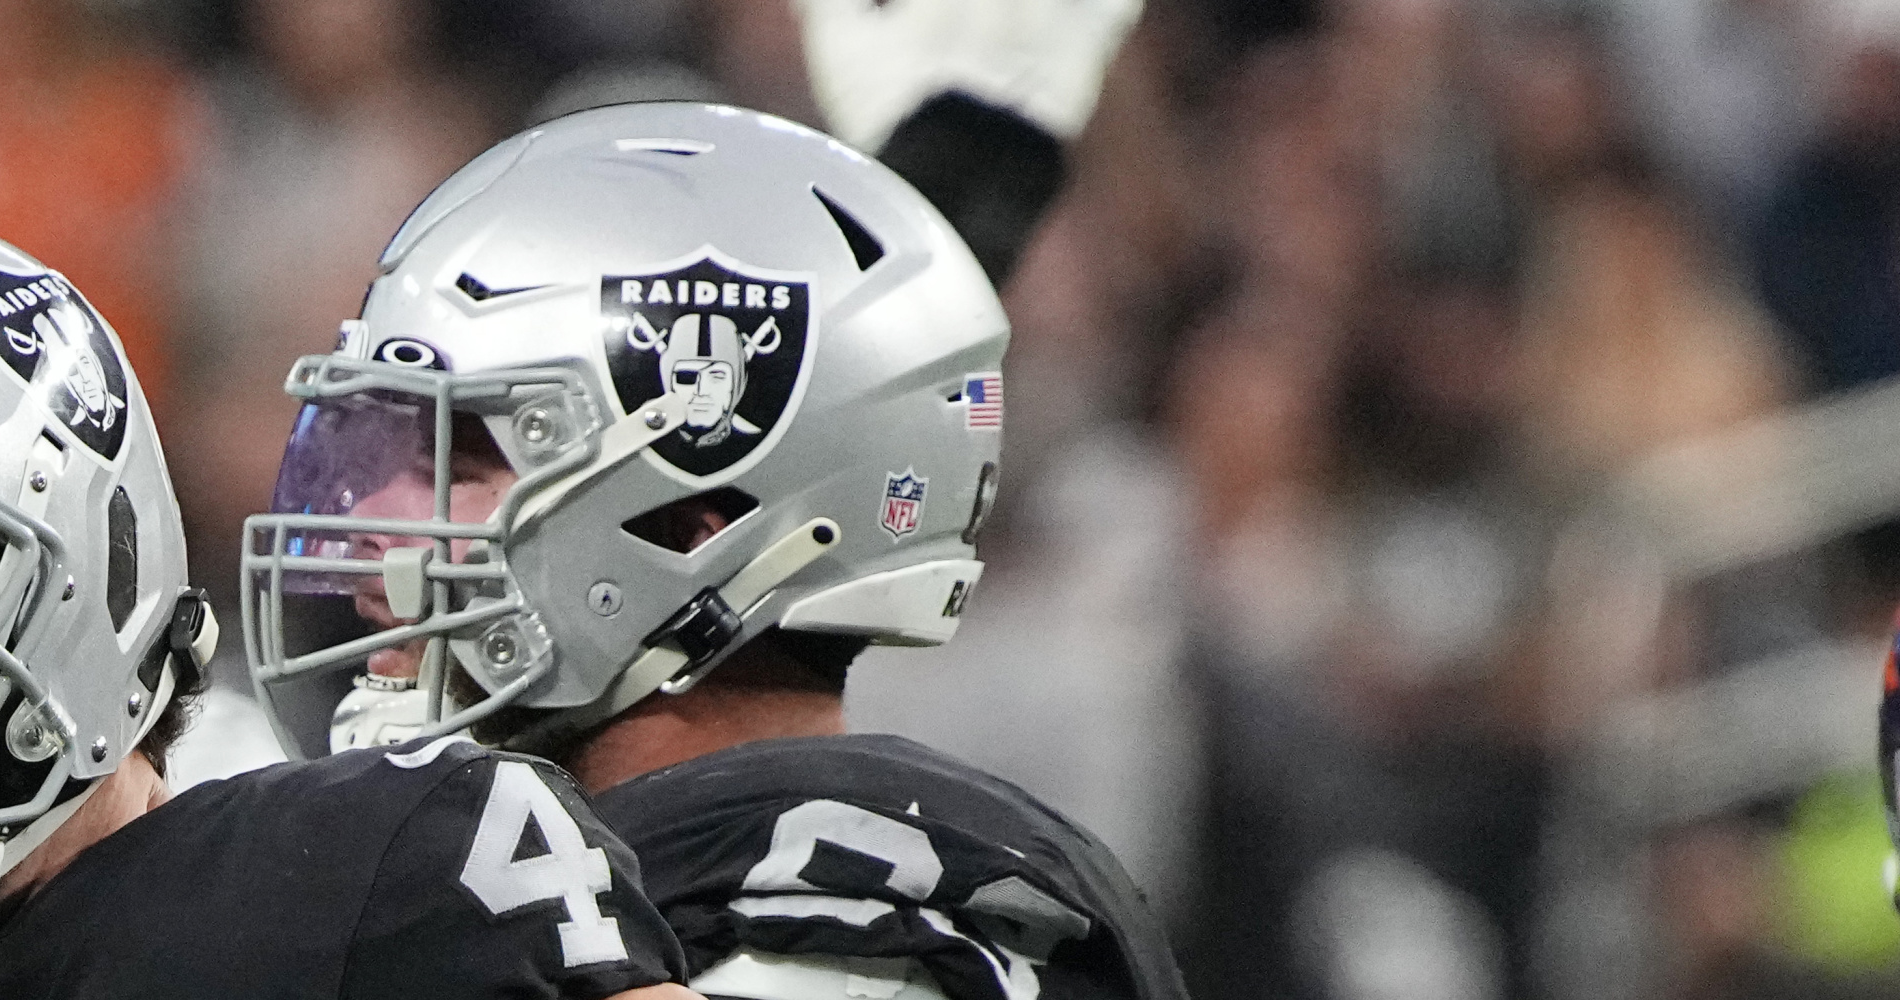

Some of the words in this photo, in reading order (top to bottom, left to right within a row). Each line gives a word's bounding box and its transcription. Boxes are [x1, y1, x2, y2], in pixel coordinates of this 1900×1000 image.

[620, 279, 791, 310] RAIDERS
[884, 498, 918, 531] NFL
[460, 760, 630, 969] 4
